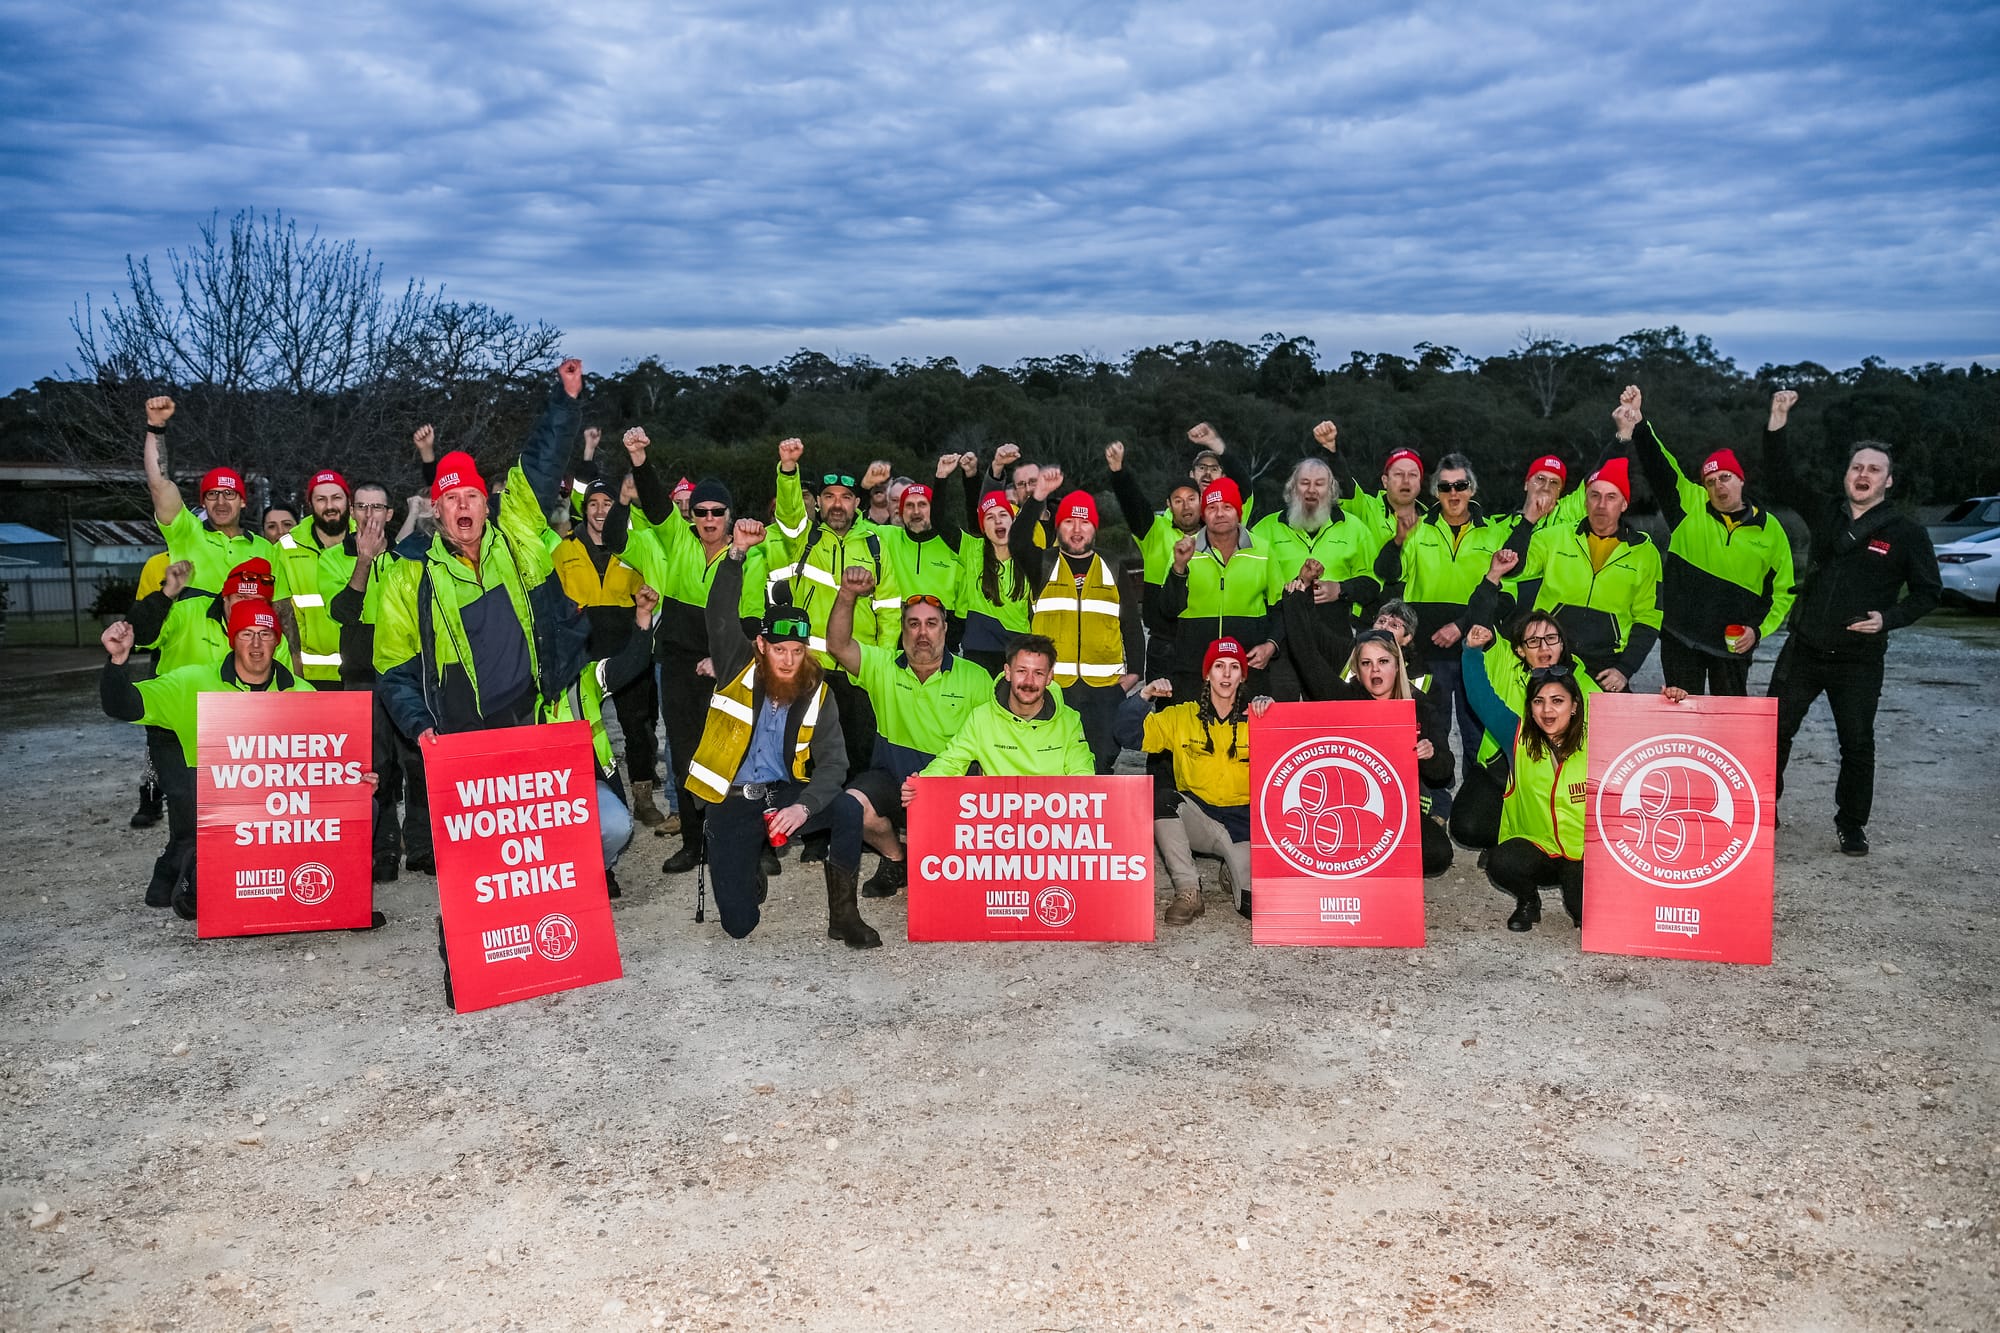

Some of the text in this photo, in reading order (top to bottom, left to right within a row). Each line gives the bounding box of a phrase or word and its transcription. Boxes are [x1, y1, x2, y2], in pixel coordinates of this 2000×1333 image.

[438, 472, 459, 486] UNITED
[226, 734, 348, 760] WINERY
[210, 761, 363, 789] WORKERS
[1272, 744, 1392, 788] WINE INDUSTRY WORKERS
[1612, 742, 1745, 791] WINE INDUSTRY WORKERS
[455, 769, 572, 808] WINERY
[1568, 782, 1587, 795] UNI
[265, 791, 310, 816] ON
[958, 792, 1108, 819] SUPPORT
[234, 818, 341, 846] STRIKE
[443, 798, 590, 842] WORKERS
[954, 824, 1112, 850] REGIONAL
[1280, 828, 1394, 872] UNITED WORKERS UNION
[501, 836, 545, 866] ON
[1615, 837, 1743, 881] UNITED WORKERS UNION
[235, 869, 285, 887] UNITED
[920, 854, 1147, 881] COMMUNITIES
[238, 886, 284, 897] WORKERS UNION
[474, 862, 576, 903] STRIKE
[986, 890, 1029, 906] UNITED
[1320, 897, 1360, 911] UNITED
[1655, 905, 1700, 923] UNITED
[482, 924, 530, 949] UNITED
[1656, 923, 1698, 932] WORKERS UNION
[487, 945, 531, 961] WORKERS UNION
